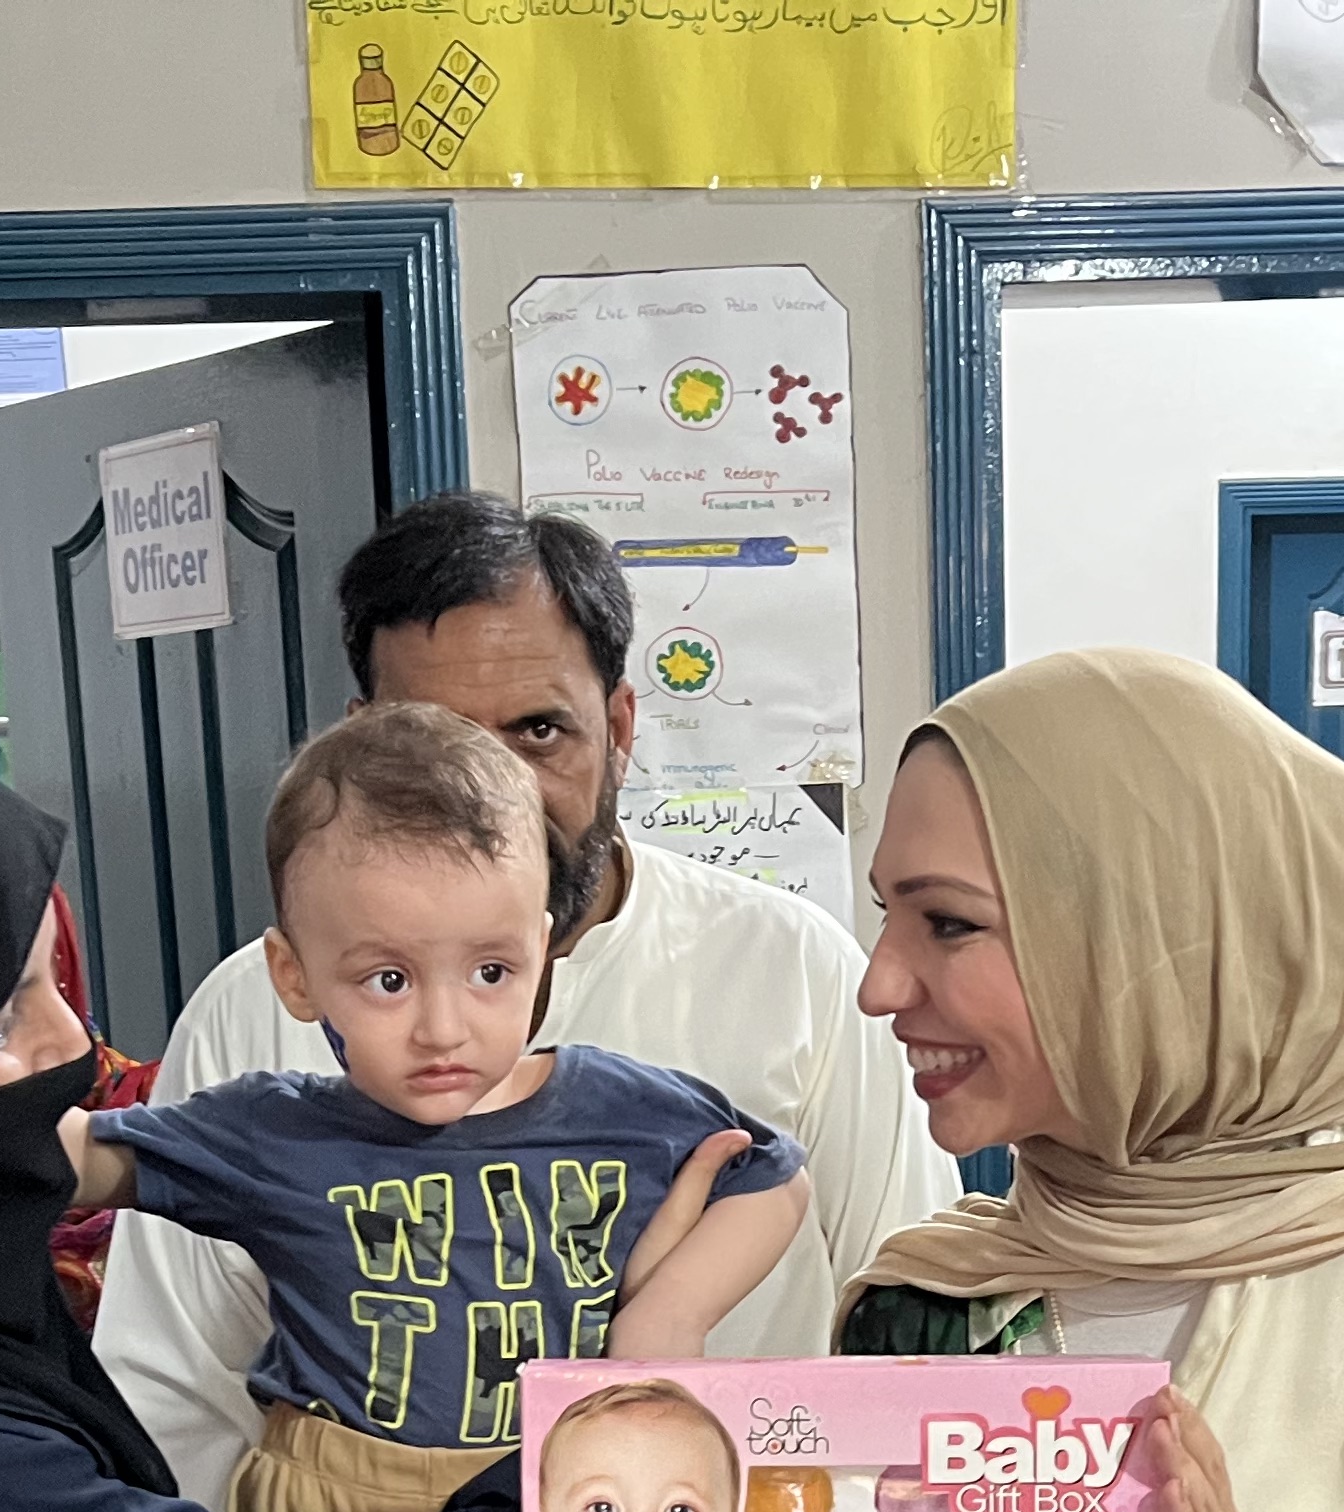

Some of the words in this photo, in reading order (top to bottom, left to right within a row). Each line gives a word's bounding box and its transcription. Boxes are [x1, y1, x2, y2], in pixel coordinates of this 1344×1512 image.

[112, 471, 212, 535] Medical
[123, 543, 209, 594] Officer
[746, 1427, 830, 1457] touch
[749, 1396, 818, 1437] Soft
[927, 1420, 1135, 1488] Baby
